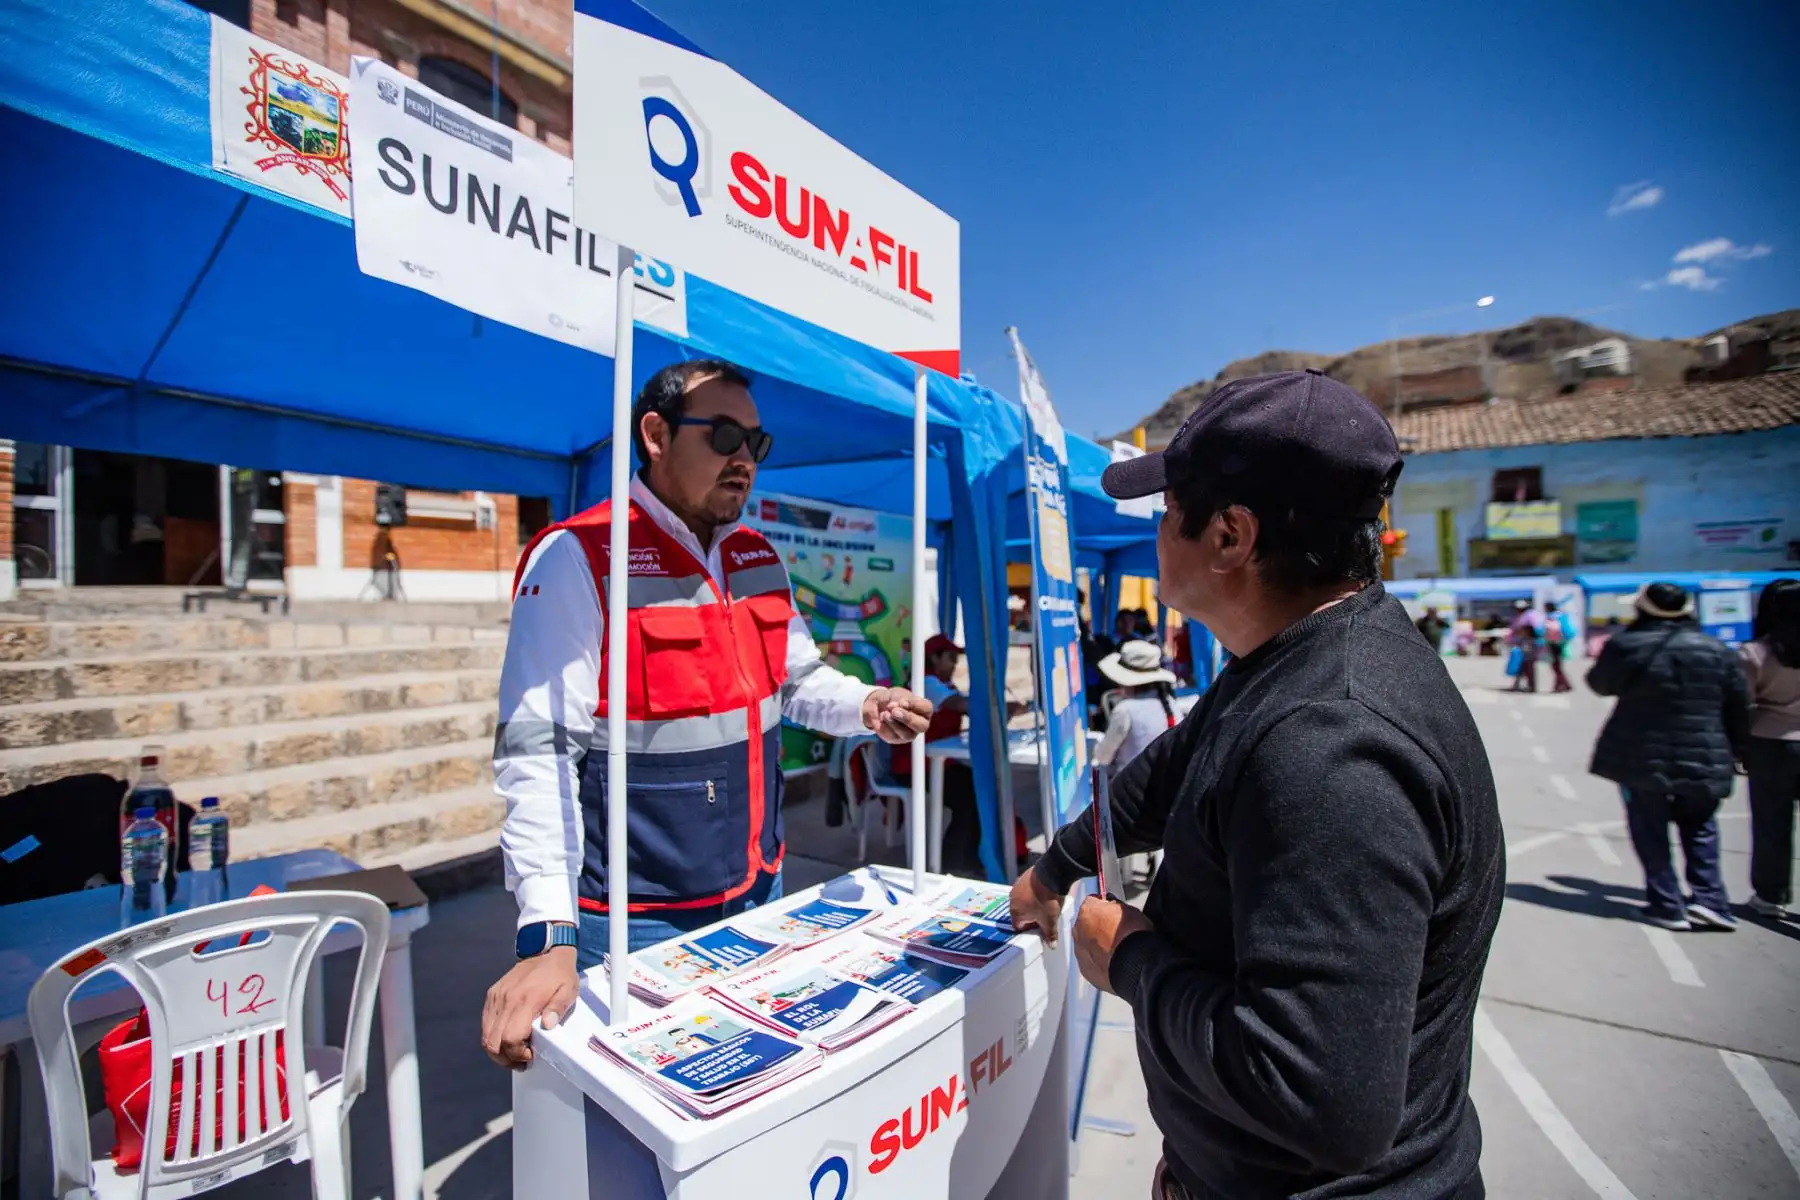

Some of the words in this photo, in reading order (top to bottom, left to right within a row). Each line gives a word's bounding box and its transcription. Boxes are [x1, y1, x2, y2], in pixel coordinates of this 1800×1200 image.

[405, 97, 430, 116] PERÚ
[378, 137, 611, 277] SUNAFIL
[727, 151, 933, 304] SUNAFIL
[724, 213, 810, 264] SUPERINTENDENCIA
[810, 257, 849, 283] NACIONAL
[207, 974, 276, 1016] 42
[784, 1009, 798, 1020] EL
[798, 1001, 820, 1014] ROL
[793, 1013, 808, 1024] DE
[808, 1008, 823, 1019] LA
[803, 1008, 842, 1028] SUNAFIL
[676, 1048, 719, 1075] ASPECTOS
[718, 1035, 752, 1056] BÁSICOS
[685, 1068, 699, 1079] DE
[698, 1047, 744, 1073] SEGURIDAD
[699, 1062, 727, 1080] SALUD
[726, 1057, 739, 1068] EN
[738, 1052, 751, 1063] EL
[701, 1065, 740, 1086] TRABAJO
[739, 1054, 763, 1072] (SST)
[868, 1035, 1012, 1174] SUNAFIL
